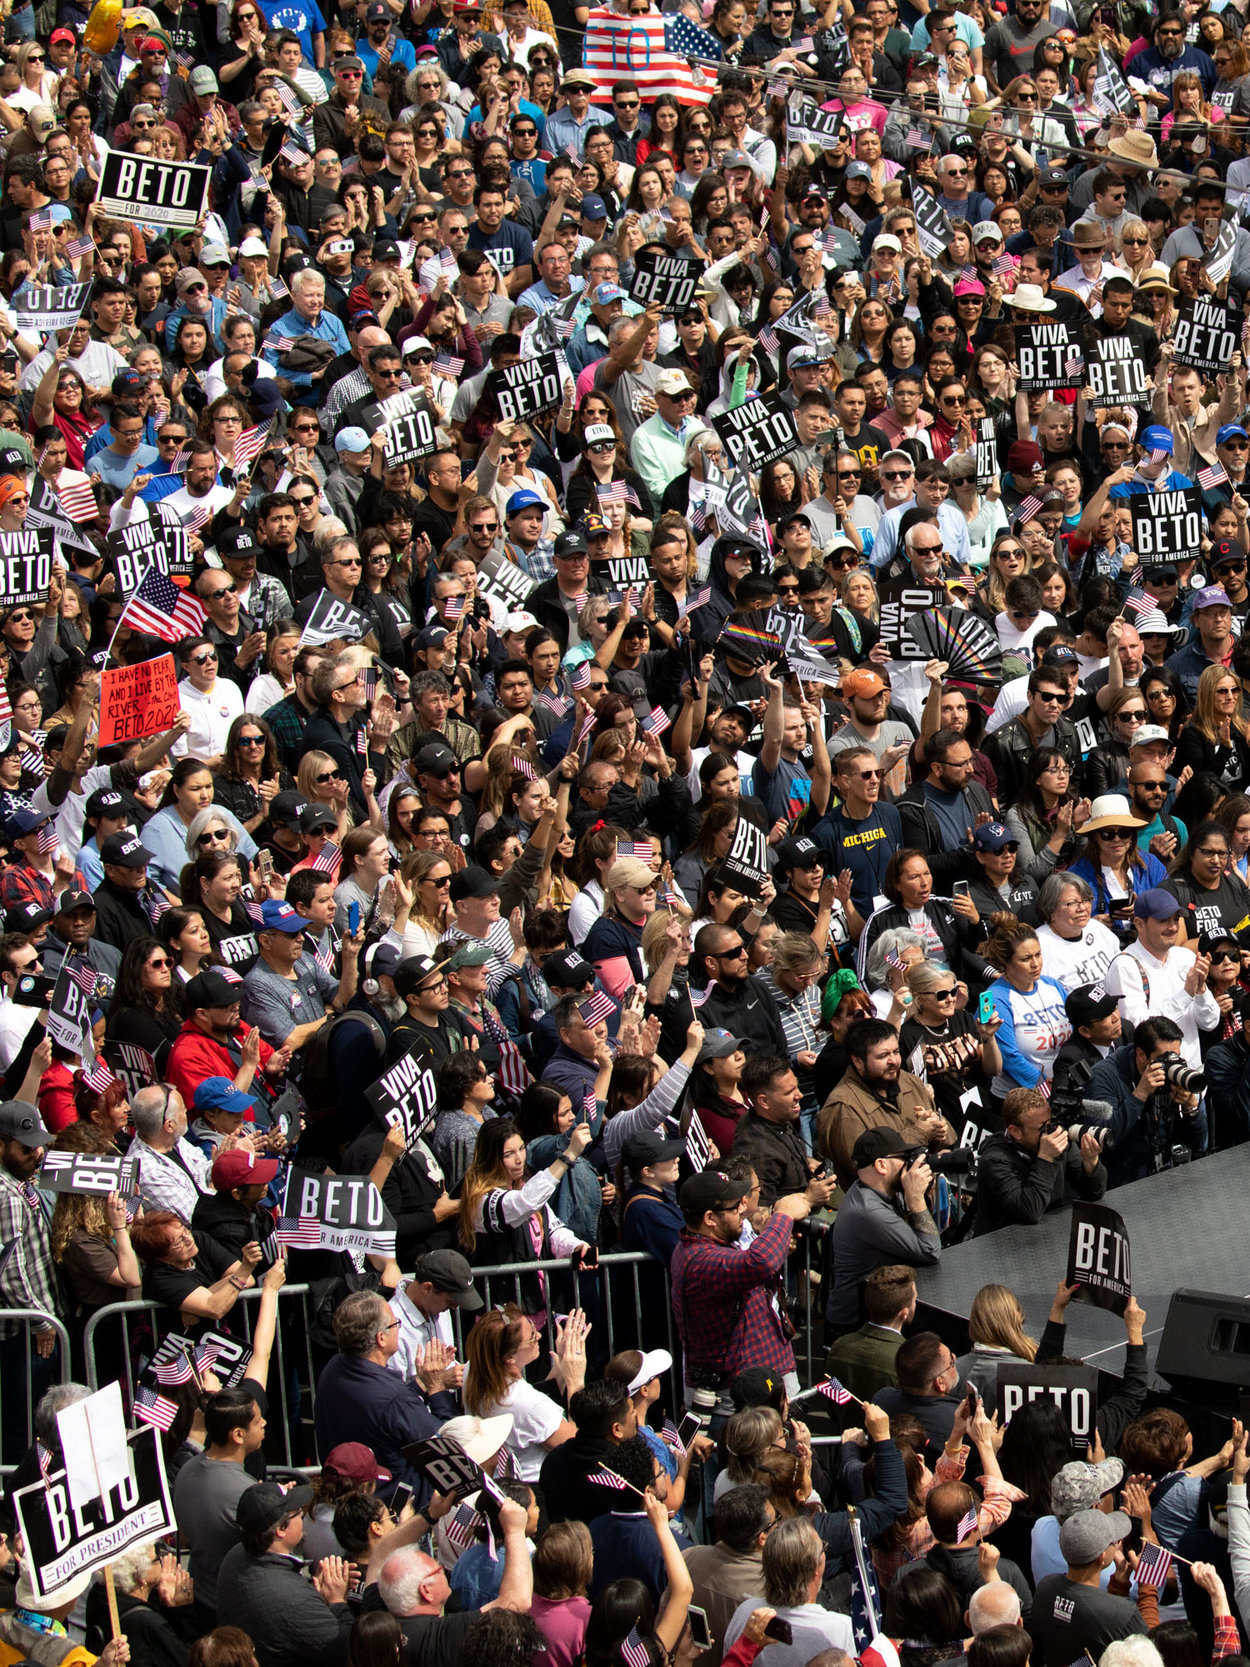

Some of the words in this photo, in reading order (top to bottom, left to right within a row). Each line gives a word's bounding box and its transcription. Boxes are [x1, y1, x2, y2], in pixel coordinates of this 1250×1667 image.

[117, 160, 191, 207] BETO
[124, 202, 141, 216] FOR
[144, 205, 171, 222] 2020
[653, 256, 689, 277] VIVA
[633, 271, 695, 307] BETO
[1192, 301, 1227, 329] VIVA
[1031, 324, 1069, 347] VIVA
[1175, 319, 1236, 361] BETO
[1097, 337, 1134, 361] VIVA
[1019, 344, 1081, 380] BETO
[1182, 359, 1192, 367] FOR
[1193, 360, 1219, 369] AMERICA
[504, 363, 544, 388] VIVA
[1032, 380, 1045, 388] FOR
[1046, 379, 1070, 388] AMERICA
[1087, 359, 1146, 397] BETO
[376, 391, 418, 420] VIVA
[496, 376, 560, 421] BETO
[1102, 396, 1115, 405] FOR
[1116, 394, 1139, 404] AMERICA
[729, 400, 769, 430] VIVA
[379, 409, 436, 458] BETO
[726, 417, 794, 464] BETO
[403, 446, 427, 461] AMERICA
[760, 446, 786, 465] AMERICA
[1147, 491, 1188, 516] VIVA
[1, 531, 40, 555] VIVA
[122, 521, 156, 550] VIVA
[236, 537, 252, 549] BETO
[1136, 511, 1200, 553] BETO
[117, 540, 169, 593] BETO
[608, 557, 650, 582] VIVA
[1151, 554, 1164, 563] FOR
[1165, 551, 1190, 562] AMERICA
[0, 553, 51, 595] BETO
[494, 559, 533, 601] VIVA
[3, 594, 15, 604] FOR
[15, 592, 39, 603] AMERICA
[879, 600, 900, 644] VIVA
[118, 669, 139, 683] HAVE
[141, 665, 152, 678] NO
[153, 660, 170, 676] FEAR
[108, 689, 126, 703] AND
[135, 681, 152, 697] LIVE
[155, 678, 165, 692] BY
[108, 699, 140, 719] RIVER
[113, 714, 145, 741] BETO
[730, 816, 768, 873] BETO
[733, 861, 744, 872] FOR
[742, 864, 762, 882] AMERICA
[1195, 905, 1222, 919] BETO
[1196, 918, 1219, 933] FOR
[1074, 950, 1111, 985] BETO
[1022, 1003, 1068, 1026] BETO
[60, 1025, 77, 1046] FOR
[1035, 1028, 1071, 1051] 2020
[118, 1043, 151, 1070] VIVA
[380, 1053, 421, 1102] VIVA
[385, 1068, 438, 1138] BETO
[685, 1108, 709, 1173] BETO
[300, 1176, 383, 1226] BETO
[330, 1235, 370, 1249] AMERICA
[1074, 1222, 1131, 1285] BETO
[1088, 1273, 1101, 1286] FOR
[1102, 1277, 1126, 1294] AMERICA
[54, 1557, 77, 1580] FOR
[79, 1511, 147, 1567] PRESIDENT
[1054, 1596, 1075, 1615] BETO
